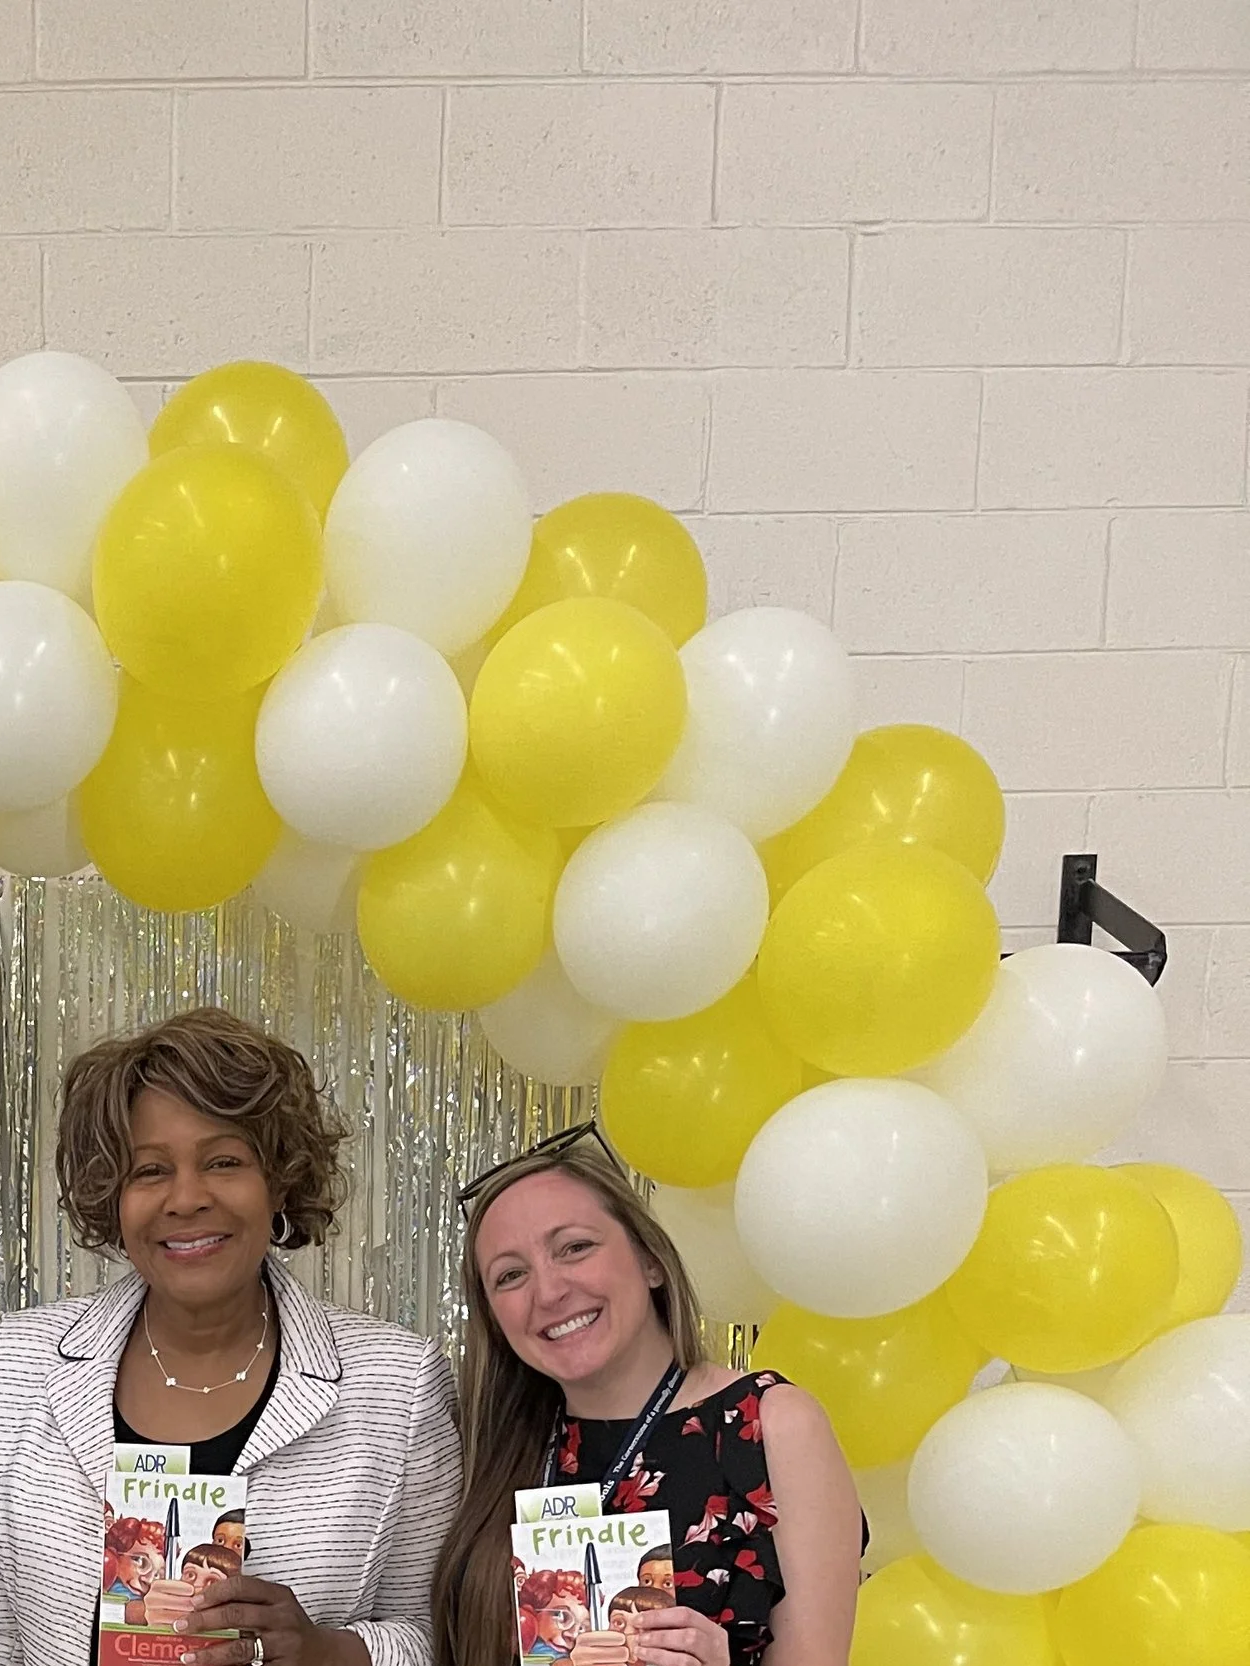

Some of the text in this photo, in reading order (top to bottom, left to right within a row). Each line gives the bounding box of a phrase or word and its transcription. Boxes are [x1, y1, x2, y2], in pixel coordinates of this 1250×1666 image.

[134, 1454, 167, 1473] ADR
[123, 1477, 227, 1508] Frindle
[541, 1495, 580, 1519] ADR
[532, 1521, 649, 1556] Frindle
[114, 1634, 209, 1658] Cleme
